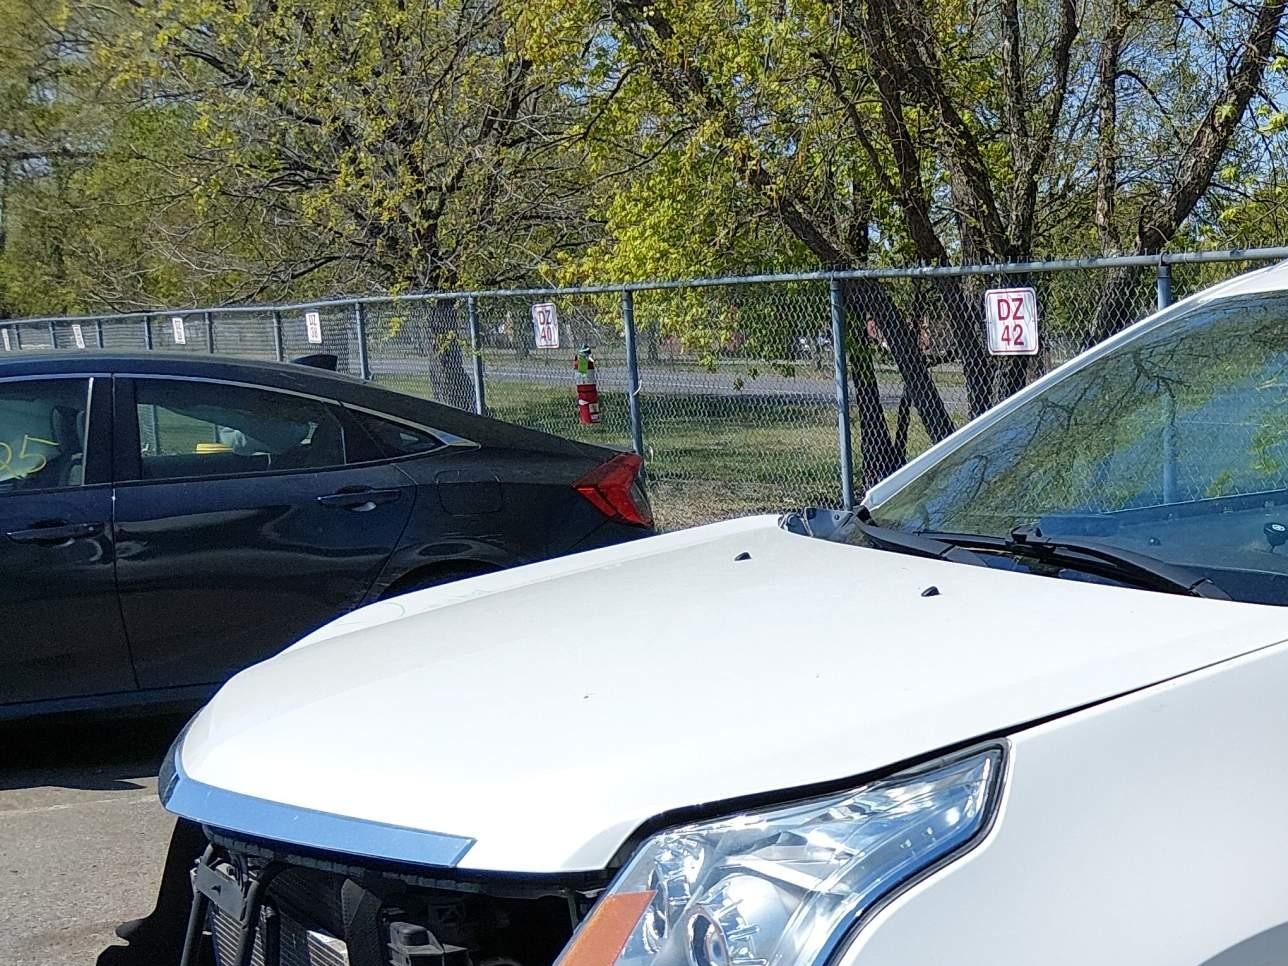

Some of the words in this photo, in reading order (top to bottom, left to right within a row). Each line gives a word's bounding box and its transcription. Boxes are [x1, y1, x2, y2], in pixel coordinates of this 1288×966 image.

[537, 310, 551, 325] DZ
[997, 297, 1025, 321] DZ
[540, 325, 553, 341] 40
[1001, 324, 1025, 346] 42
